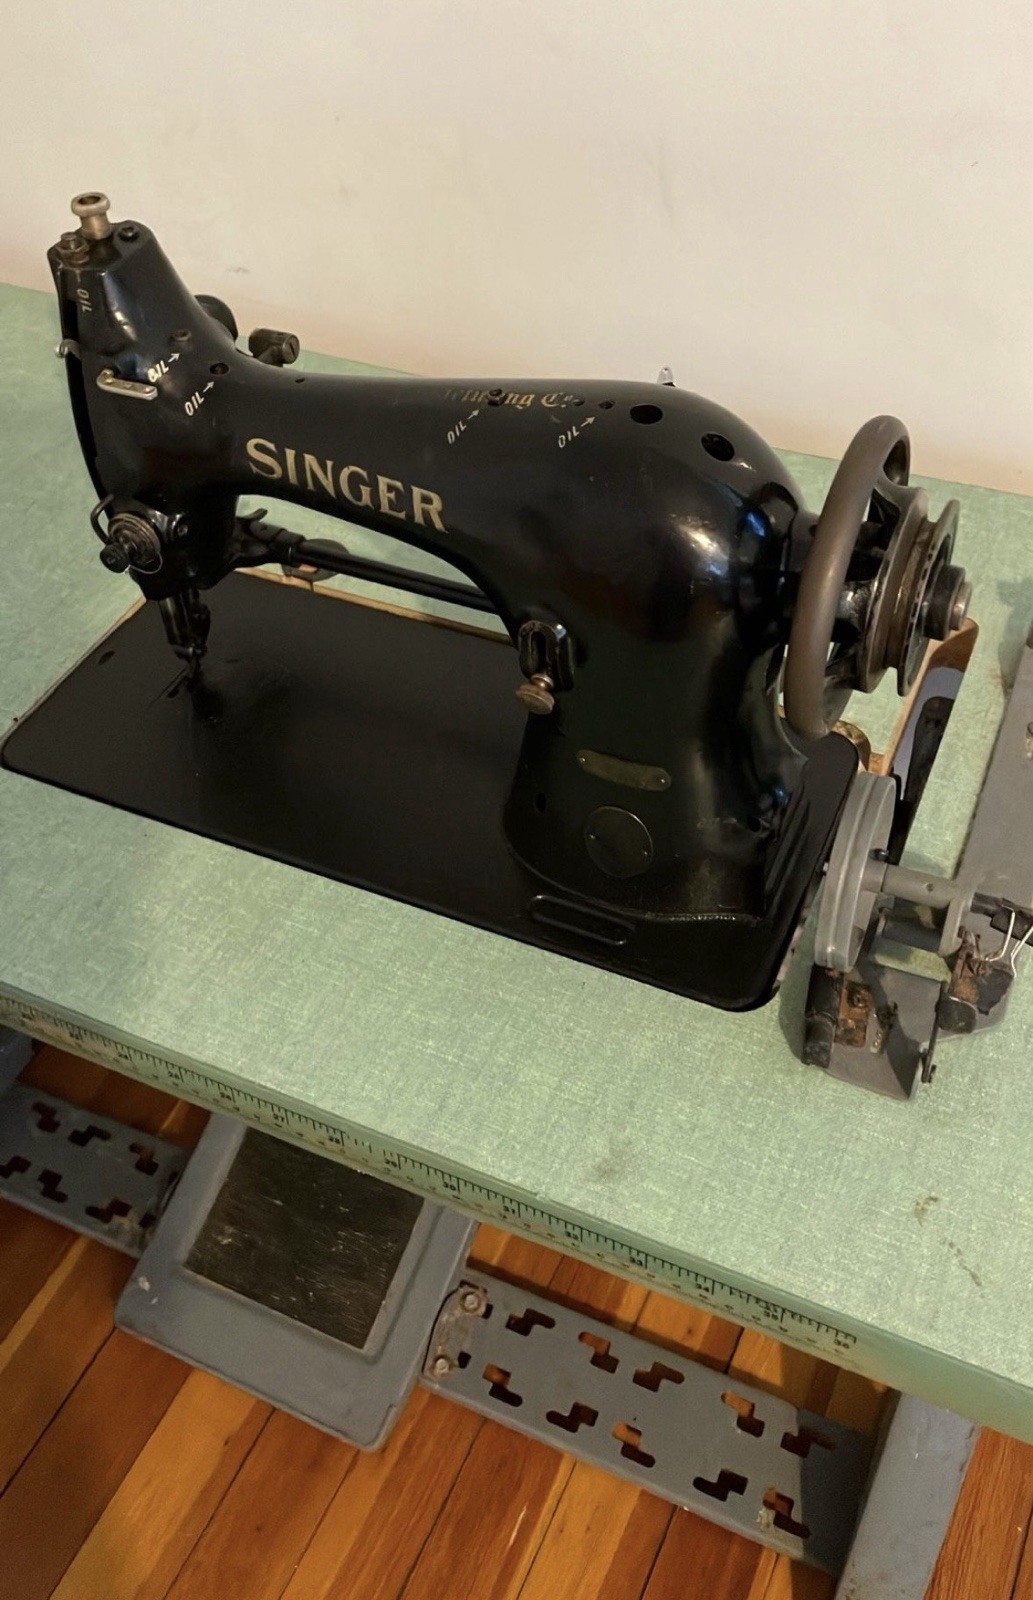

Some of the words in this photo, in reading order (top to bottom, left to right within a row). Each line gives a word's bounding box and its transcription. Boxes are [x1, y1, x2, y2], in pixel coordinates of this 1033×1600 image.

[76, 288, 93, 314] OIL
[147, 360, 170, 383] OIL
[184, 391, 205, 416] OIL
[446, 420, 467, 445] OIL
[557, 425, 580, 448] OIL
[245, 437, 450, 534] SINGER
